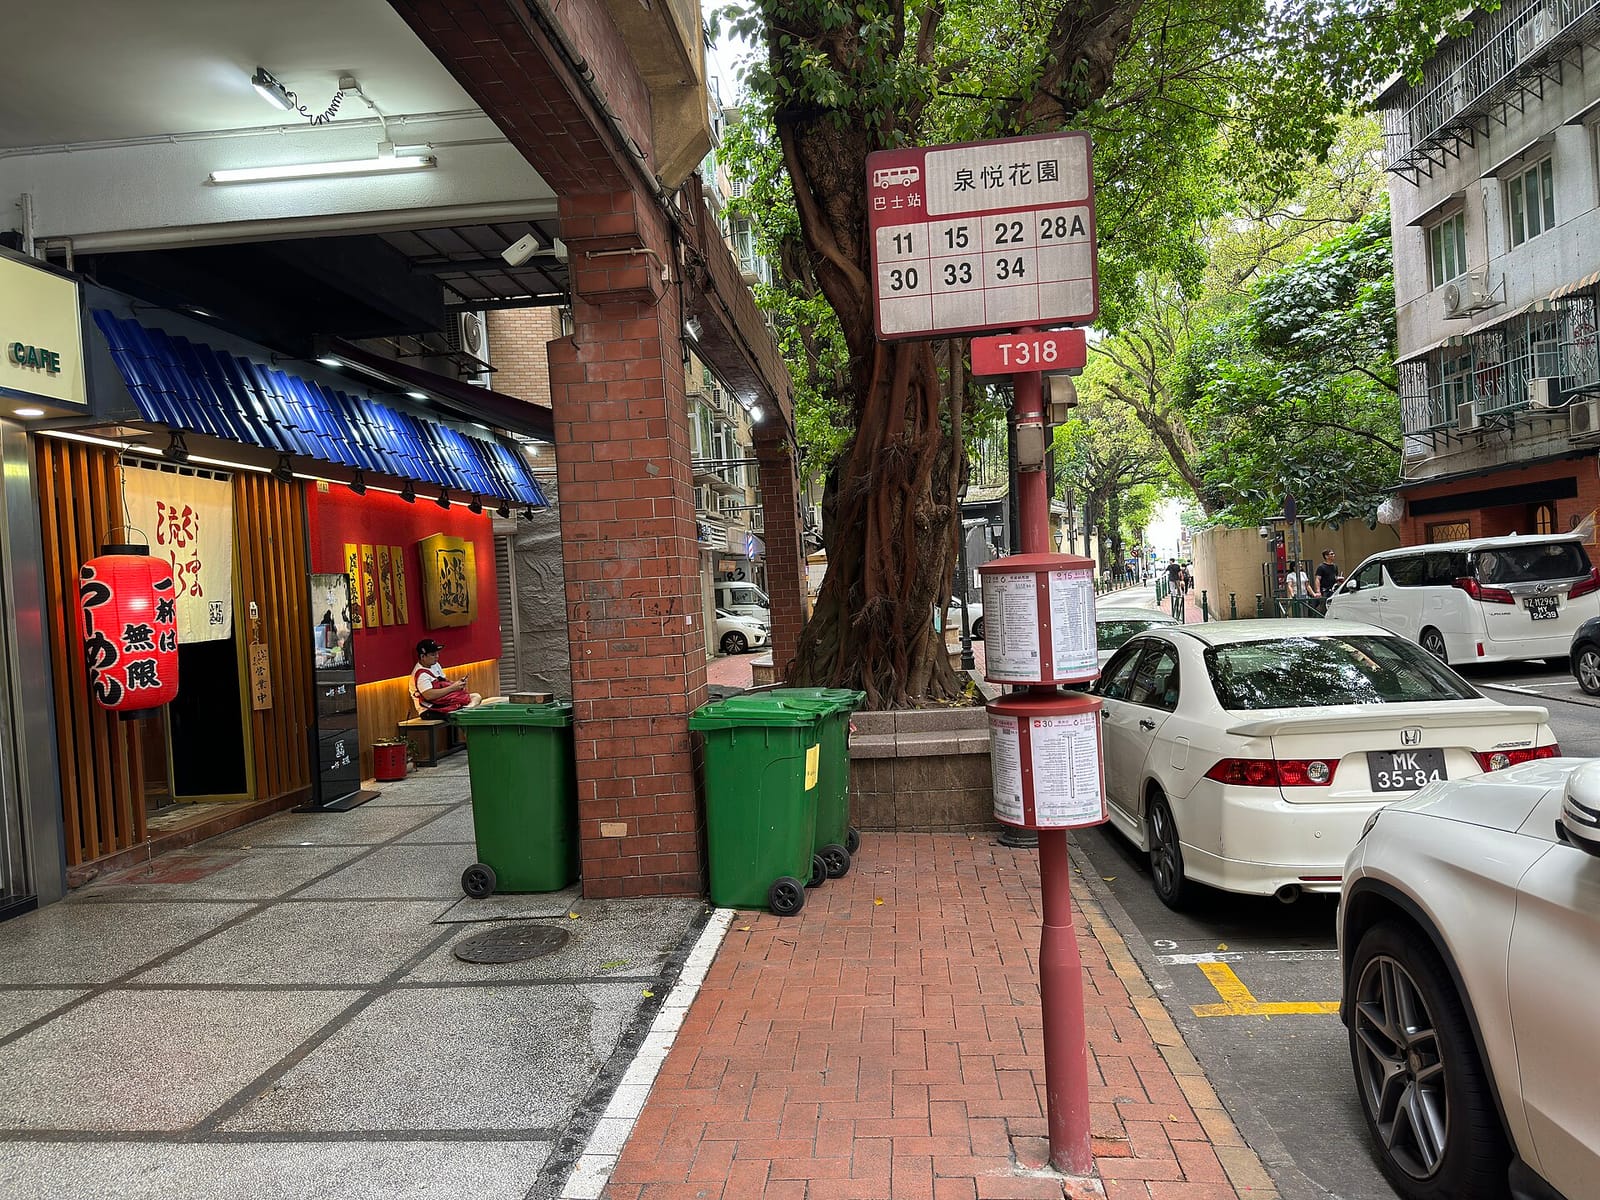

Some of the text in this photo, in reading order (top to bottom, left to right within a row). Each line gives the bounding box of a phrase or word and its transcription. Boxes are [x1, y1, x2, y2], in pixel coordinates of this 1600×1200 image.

[873, 193, 921, 210] 巴士站
[892, 214, 1086, 254] 11 15 22 28A
[890, 257, 1025, 291] 30 33 34
[9, 342, 61, 373] CAFE
[998, 340, 1058, 365] T318
[153, 577, 178, 652] 一杯は
[80, 565, 125, 707] らーめん
[121, 623, 162, 690] 無限
[1042, 720, 1053, 728] 30
[1392, 753, 1421, 770] MK
[1378, 769, 1441, 788] 35-84
